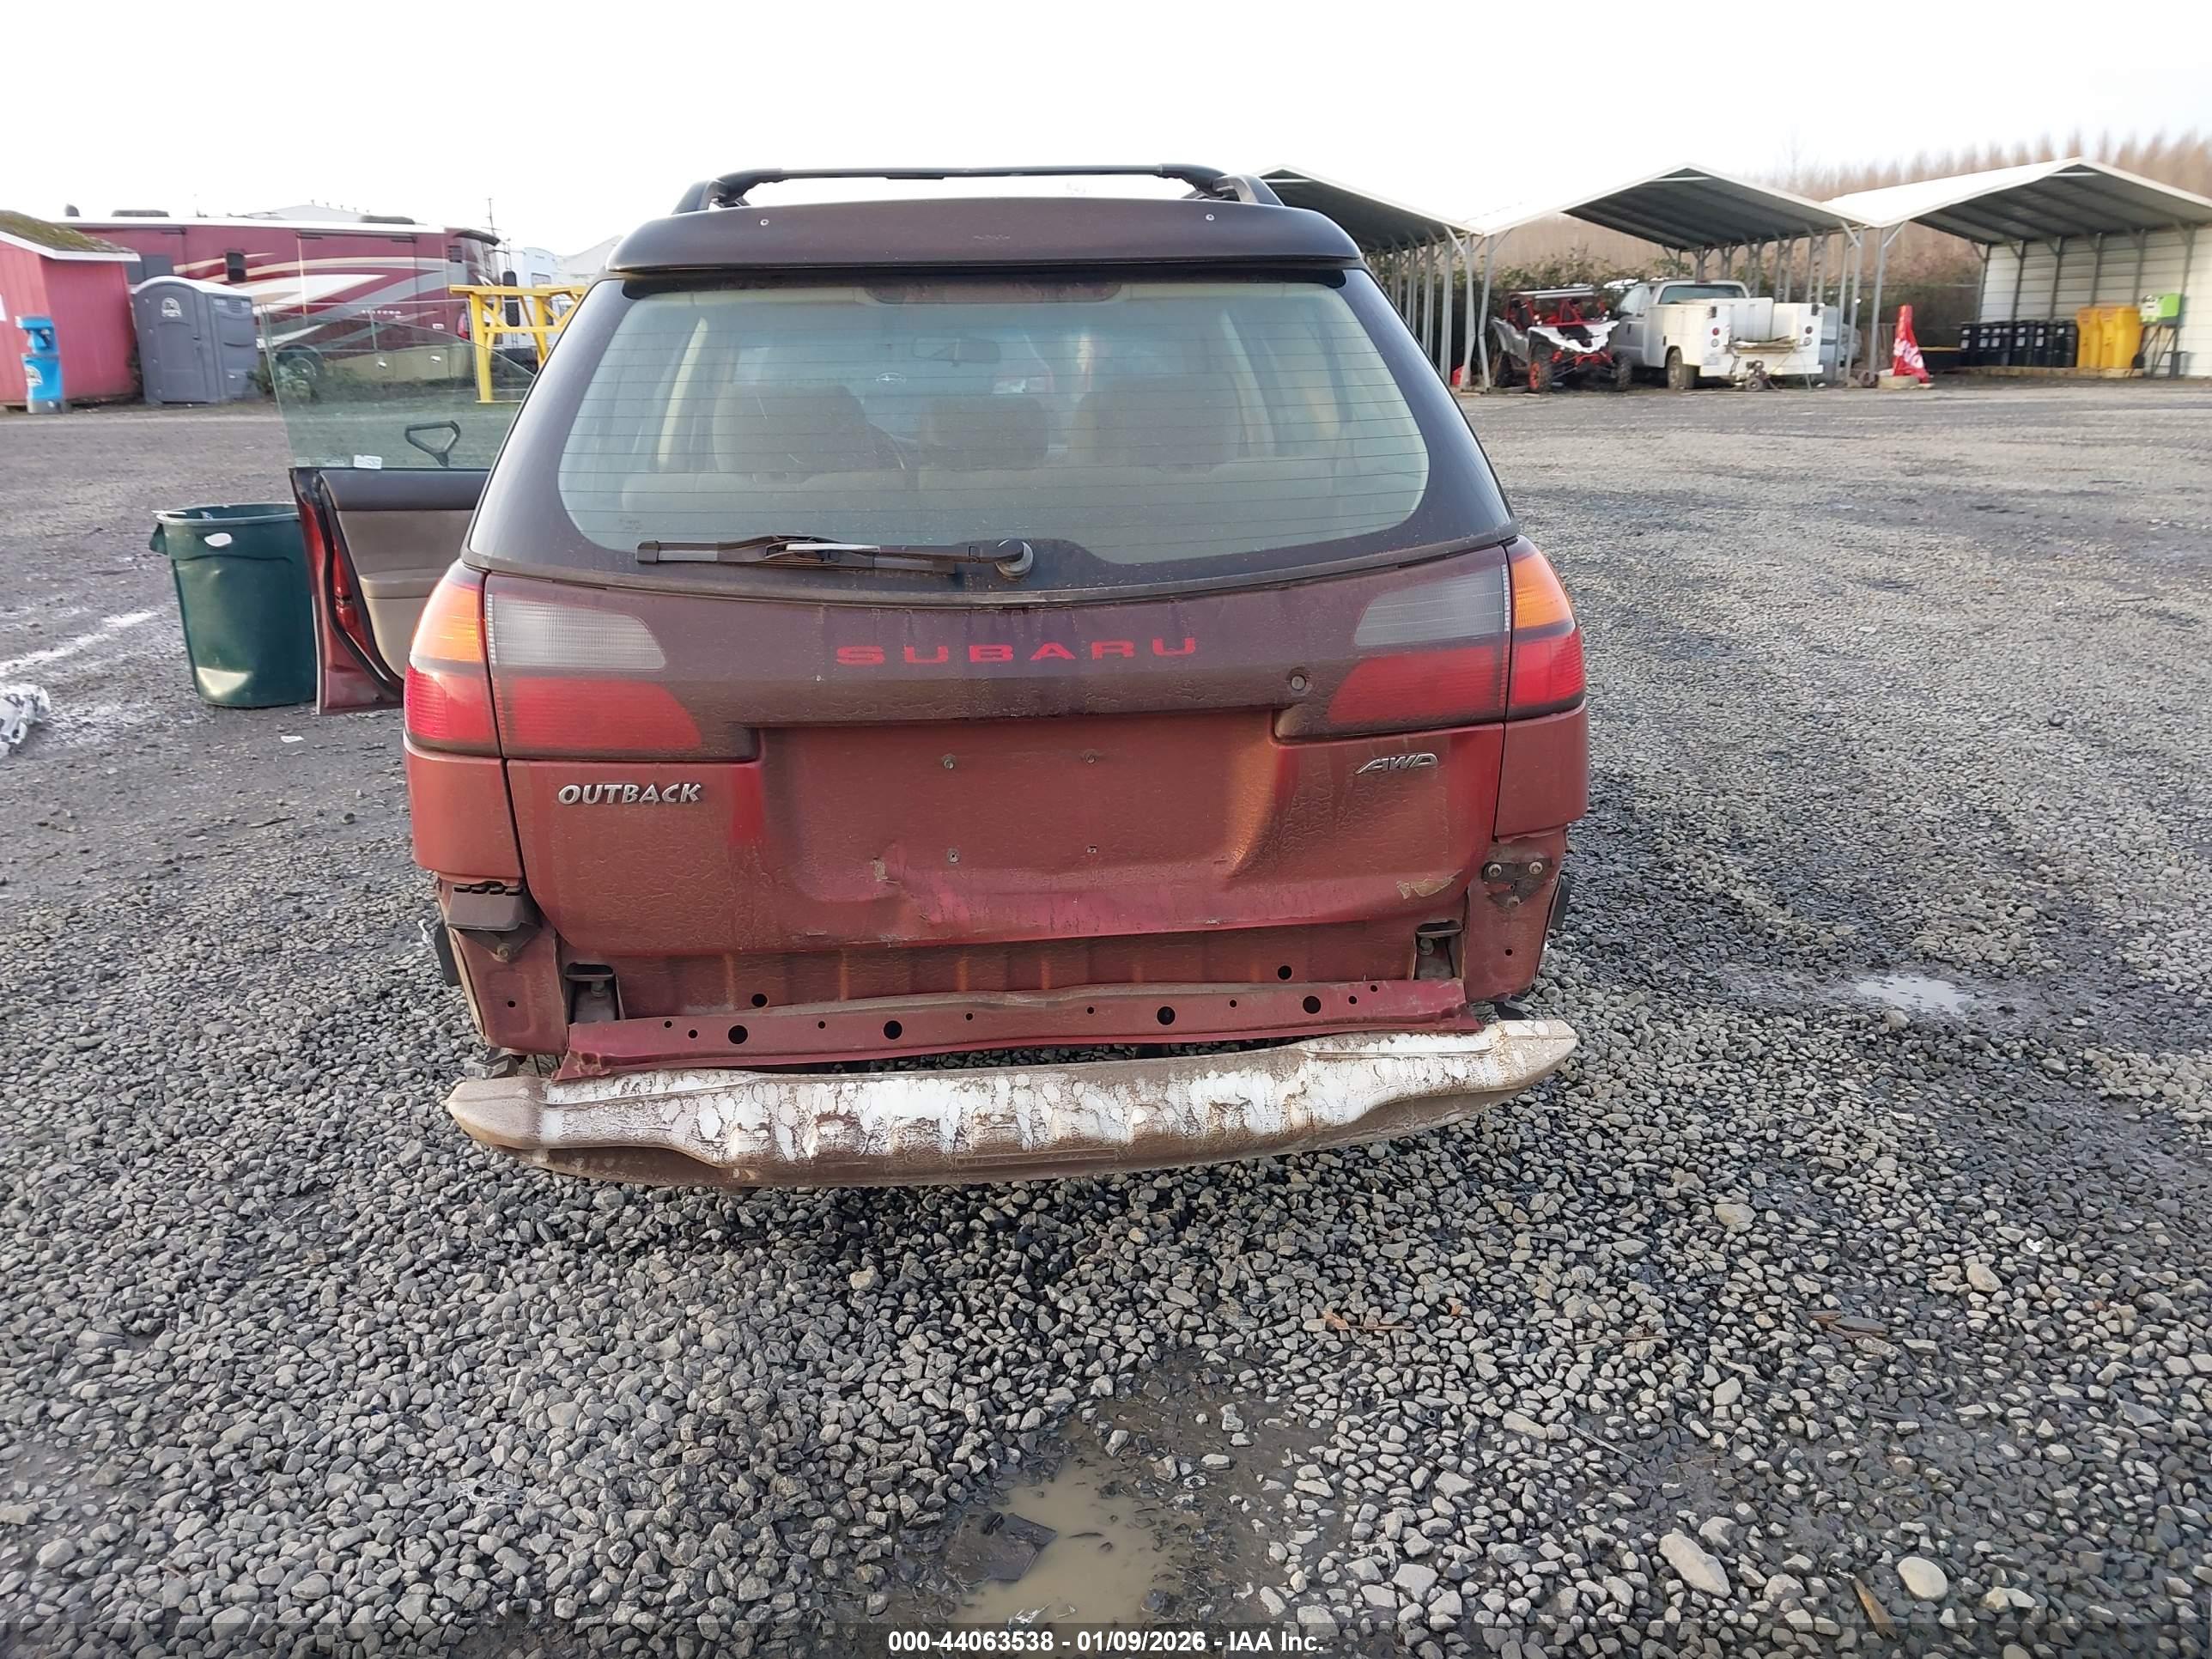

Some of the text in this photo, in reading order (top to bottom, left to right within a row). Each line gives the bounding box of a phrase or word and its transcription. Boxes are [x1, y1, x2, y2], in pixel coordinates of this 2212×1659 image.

[836, 637, 1196, 666] SUBARU
[1353, 752, 1438, 775] AWD
[557, 782, 702, 805] OUTBACK
